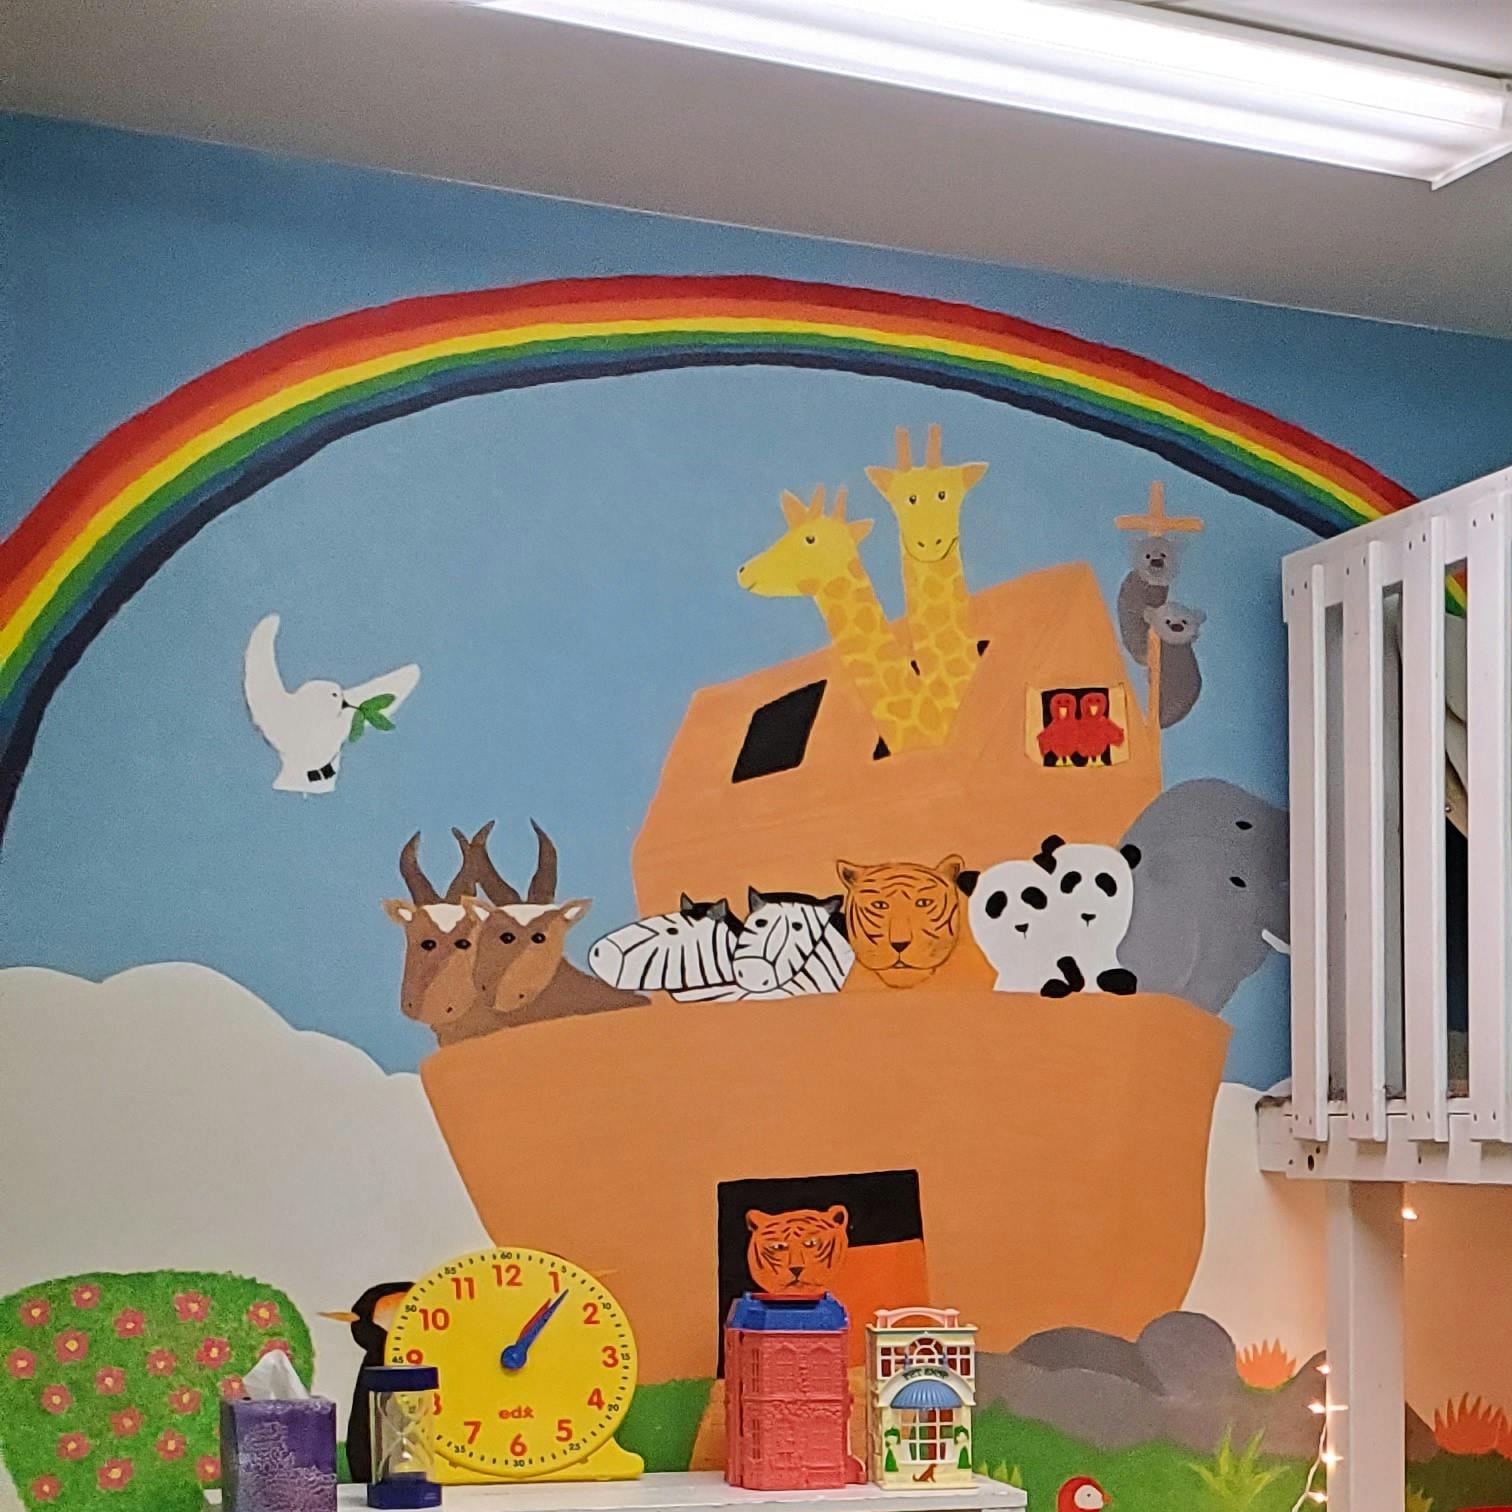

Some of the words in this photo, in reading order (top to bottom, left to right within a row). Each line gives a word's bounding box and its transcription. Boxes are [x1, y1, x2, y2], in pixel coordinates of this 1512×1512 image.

[500, 1251, 512, 1260] 60
[492, 1264, 523, 1287] 12
[548, 1271, 560, 1294] 1
[451, 1277, 475, 1300] 11
[582, 1302, 600, 1325] 2
[601, 1302, 612, 1310] 10
[419, 1308, 450, 1331] 10
[392, 1356, 404, 1364] 45
[602, 1345, 619, 1368] 3
[621, 1353, 631, 1361] 15
[587, 1387, 605, 1410] 4
[608, 1404, 619, 1412] 20
[463, 1421, 482, 1444] 7
[556, 1419, 573, 1442] 5
[454, 1445, 466, 1453] 35
[510, 1433, 527, 1457] 6
[569, 1443, 581, 1451] 25
